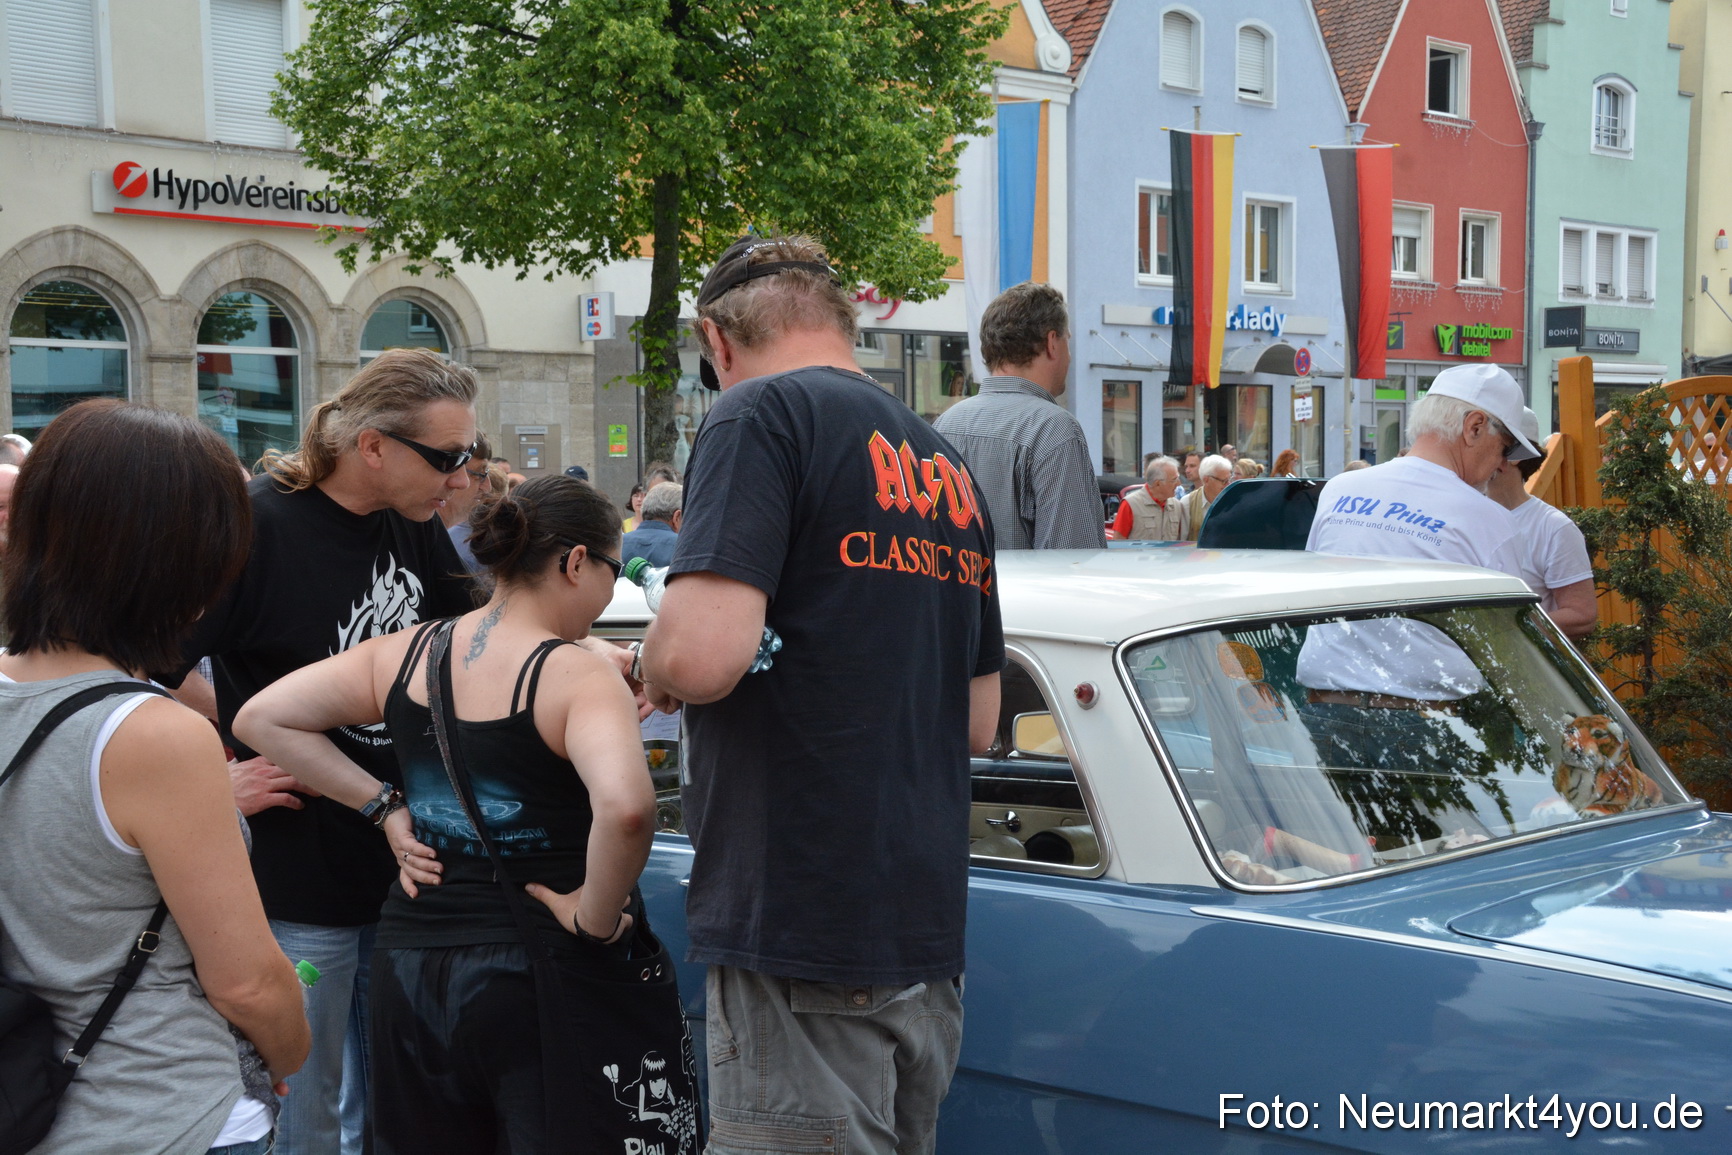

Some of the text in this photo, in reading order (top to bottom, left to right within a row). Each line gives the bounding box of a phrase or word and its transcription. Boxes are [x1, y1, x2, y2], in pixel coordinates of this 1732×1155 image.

[1462, 322, 1513, 340] mobilcom
[1548, 326, 1579, 338] BONITA
[1598, 331, 1625, 348] BONITA
[1461, 340, 1492, 356] debitel
[1332, 495, 1447, 533] NSU Prinz
[1345, 517, 1364, 527] Prinz
[1366, 521, 1383, 530] und
[1385, 523, 1396, 532] du
[1398, 525, 1415, 537] bist
[1416, 530, 1442, 547] König
[839, 531, 951, 581] CLASSIC
